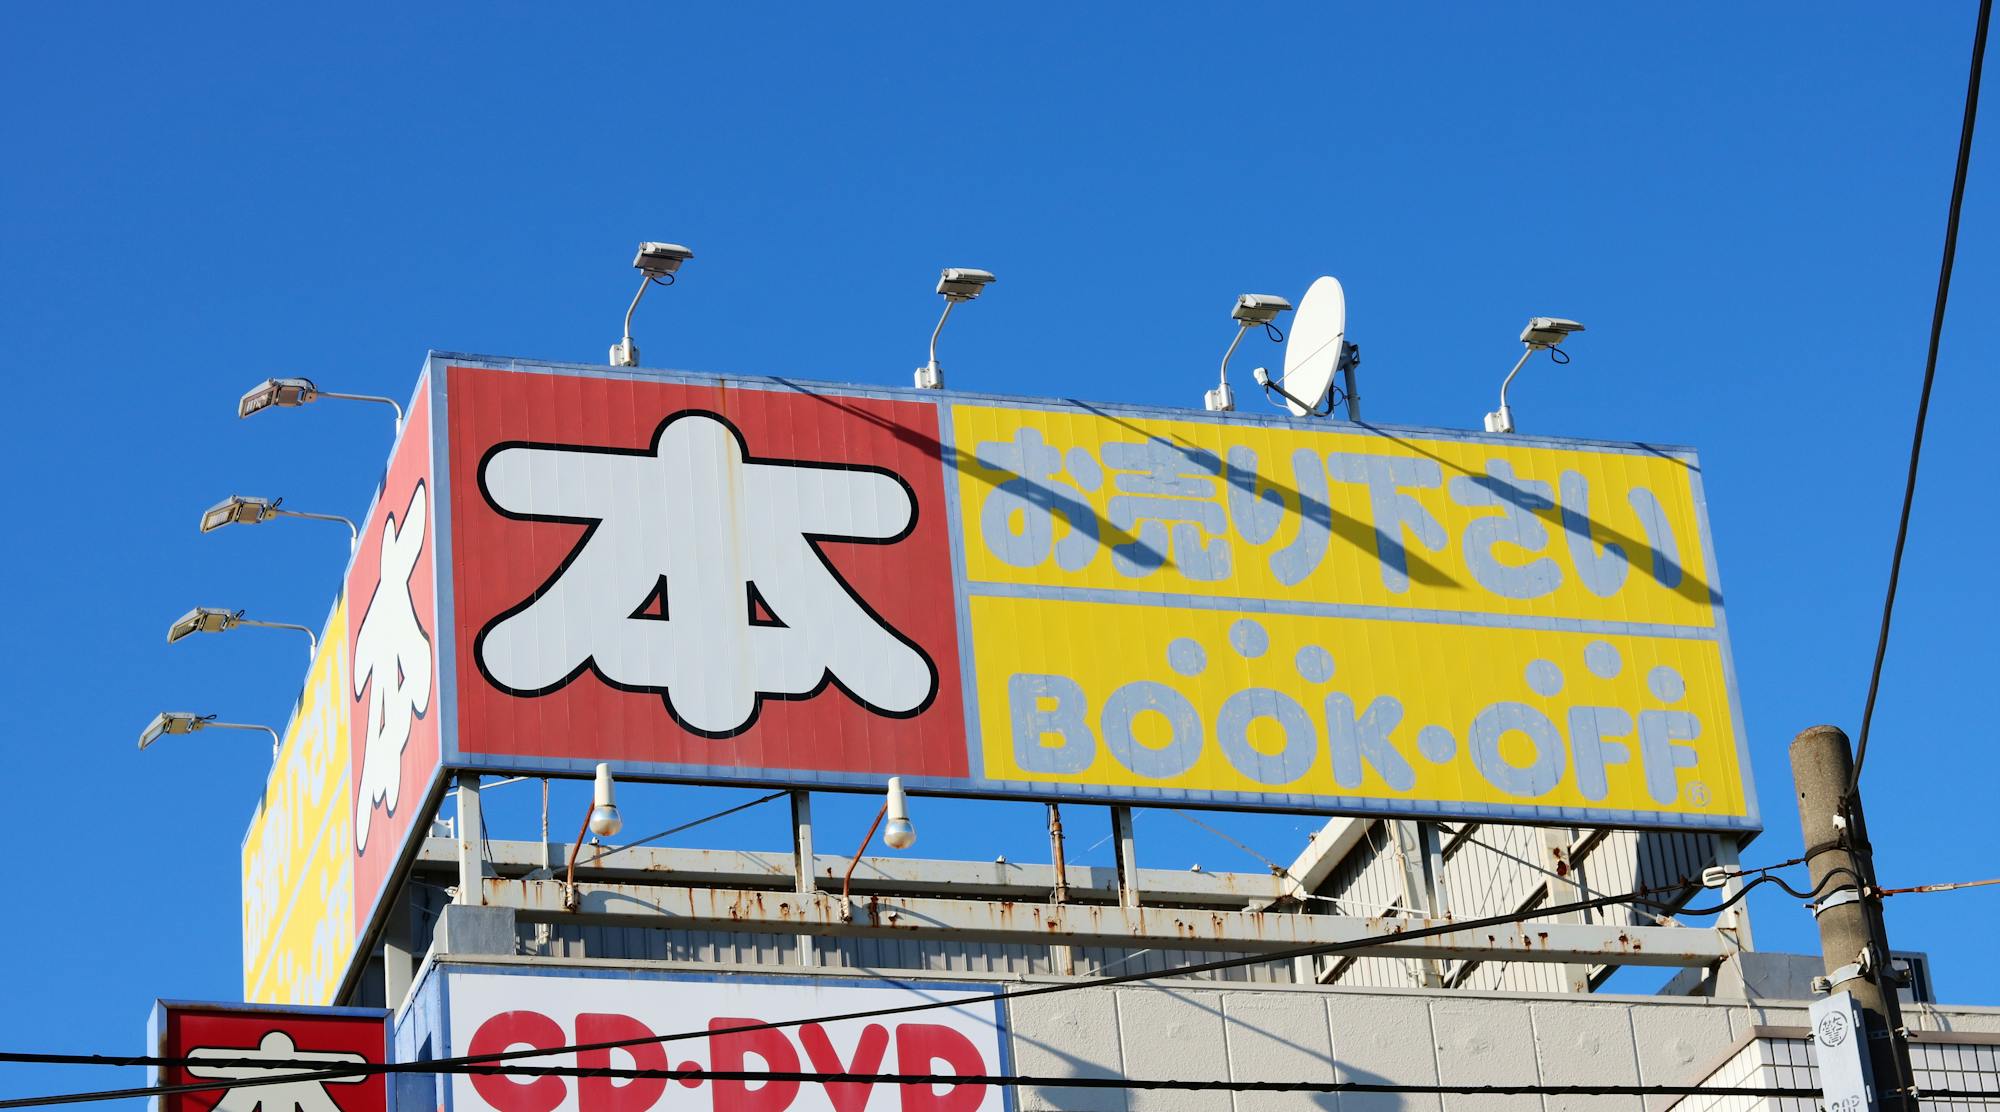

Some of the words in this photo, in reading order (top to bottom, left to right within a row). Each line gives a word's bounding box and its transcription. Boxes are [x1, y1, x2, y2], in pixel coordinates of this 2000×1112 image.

[473, 408, 939, 739] 本
[974, 426, 1683, 599] お売り下さい
